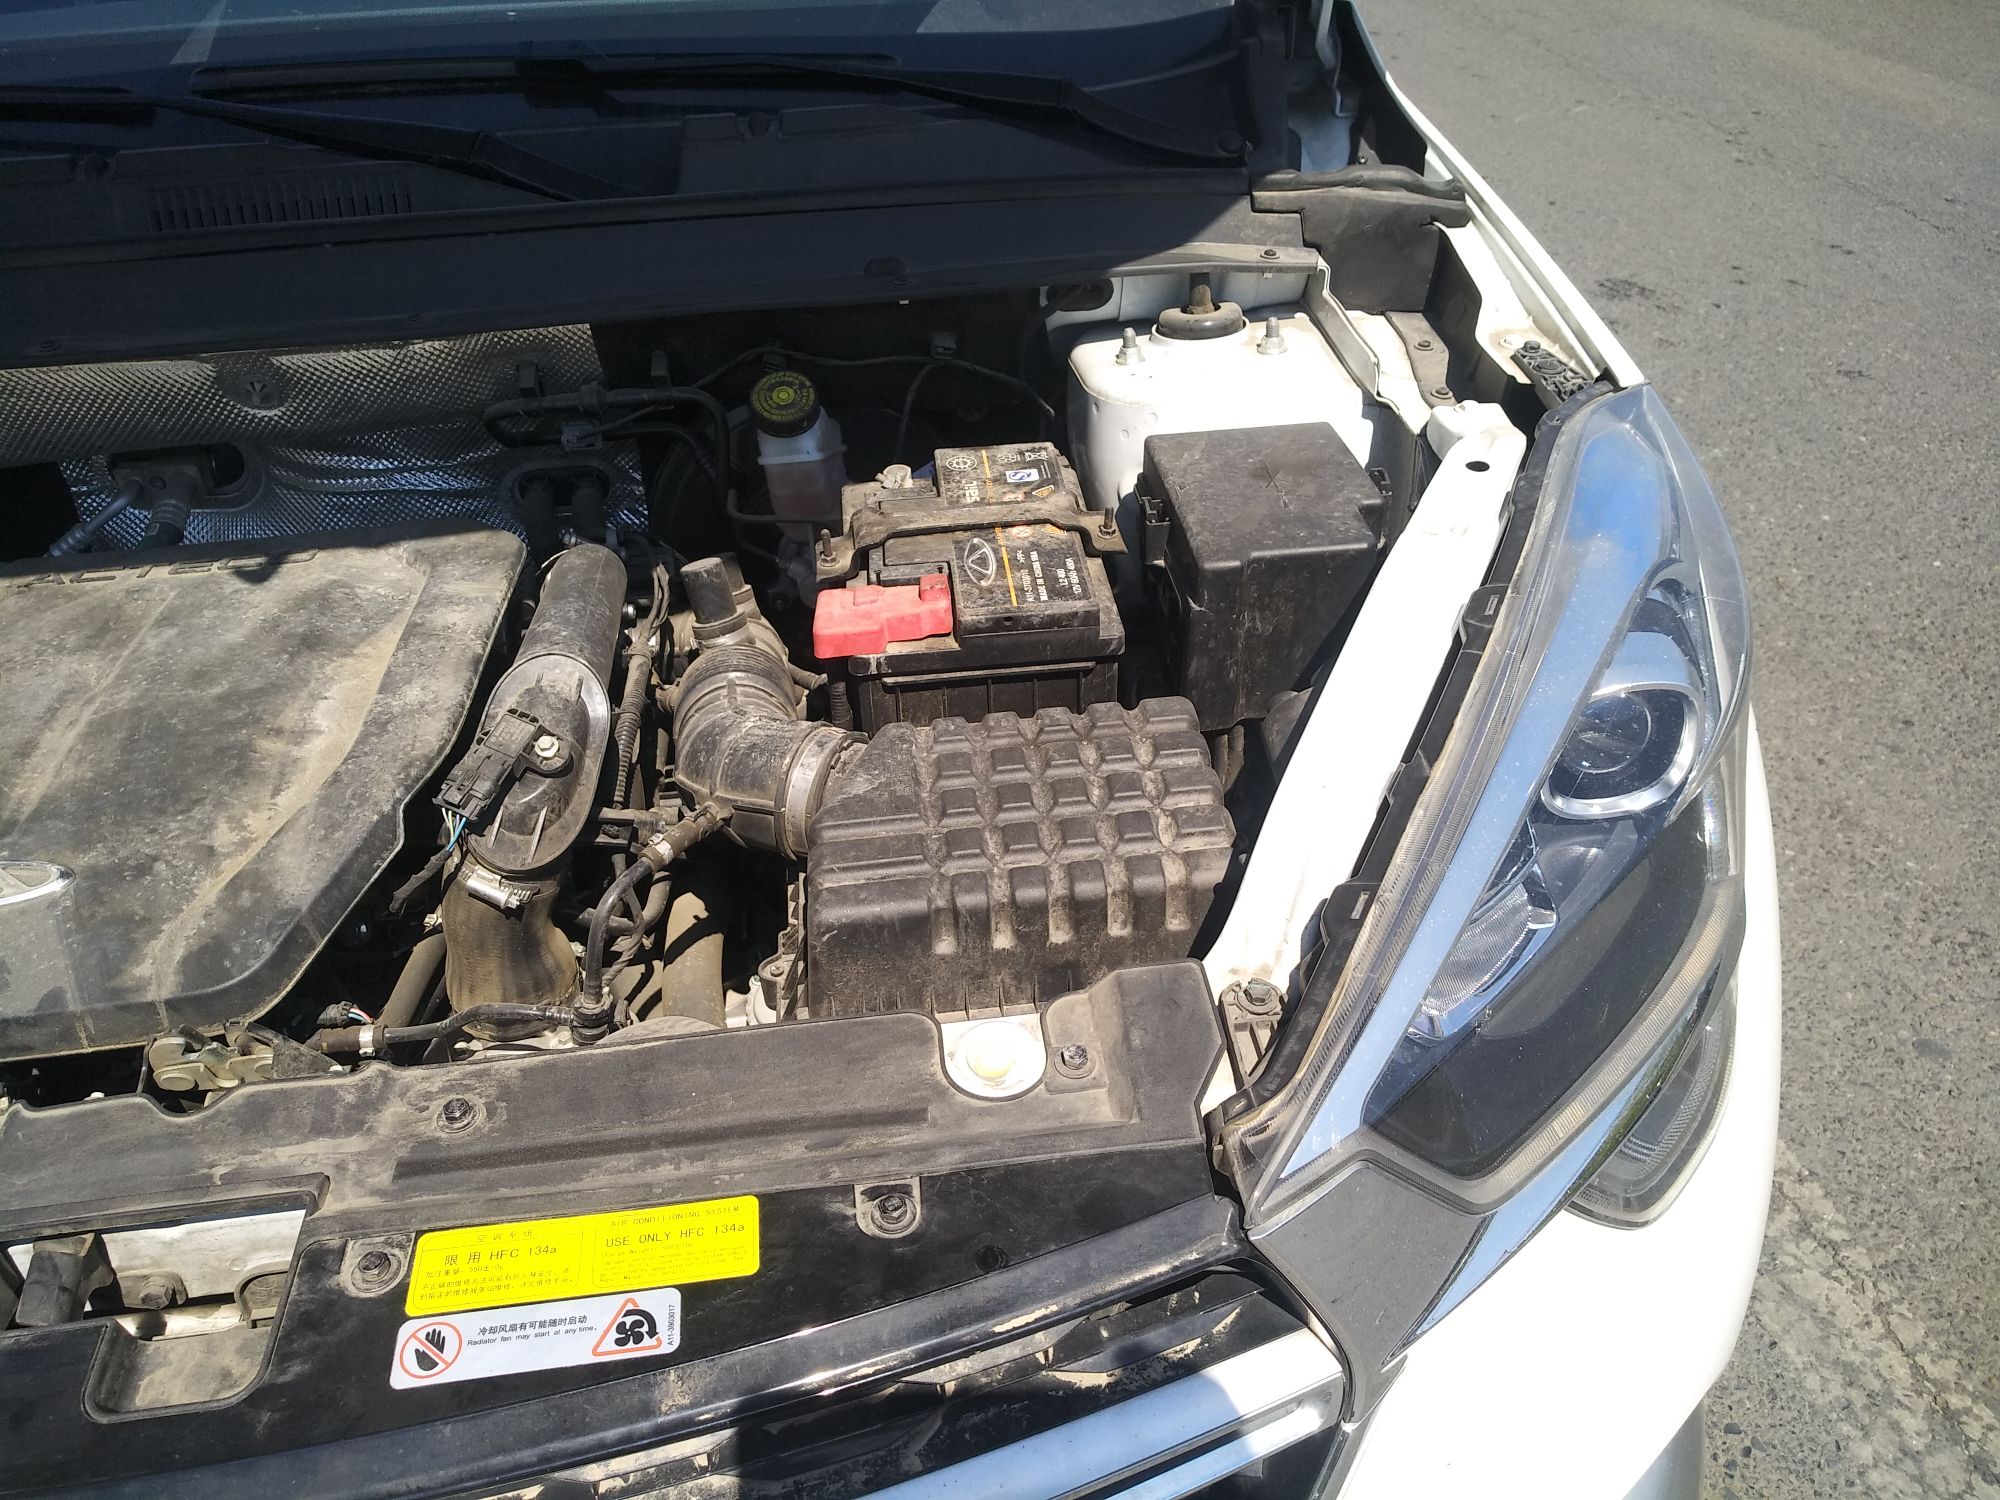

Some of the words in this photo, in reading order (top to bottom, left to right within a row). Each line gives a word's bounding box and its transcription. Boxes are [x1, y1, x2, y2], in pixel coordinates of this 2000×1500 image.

[1032, 561, 1043, 577] CHINA
[1037, 585, 1049, 601] MADE
[610, 1219, 628, 1228] AIR
[632, 1210, 700, 1225] CONDITIONING
[705, 1205, 739, 1216] SYSTEM
[605, 1235, 631, 1248] USE
[638, 1231, 672, 1244] ONLY
[680, 1227, 705, 1239] HFC
[715, 1223, 745, 1235] 134a
[489, 1248, 520, 1261] HFC
[529, 1245, 557, 1256] 134a
[477, 1314, 588, 1336] 冷却风扇有可能随时启动
[666, 1304, 676, 1346] A11-3903017
[467, 1336, 497, 1346] Radiator
[500, 1334, 512, 1342] fan
[515, 1333, 531, 1342] may
[534, 1330, 550, 1338] start
[564, 1328, 577, 1337] any
